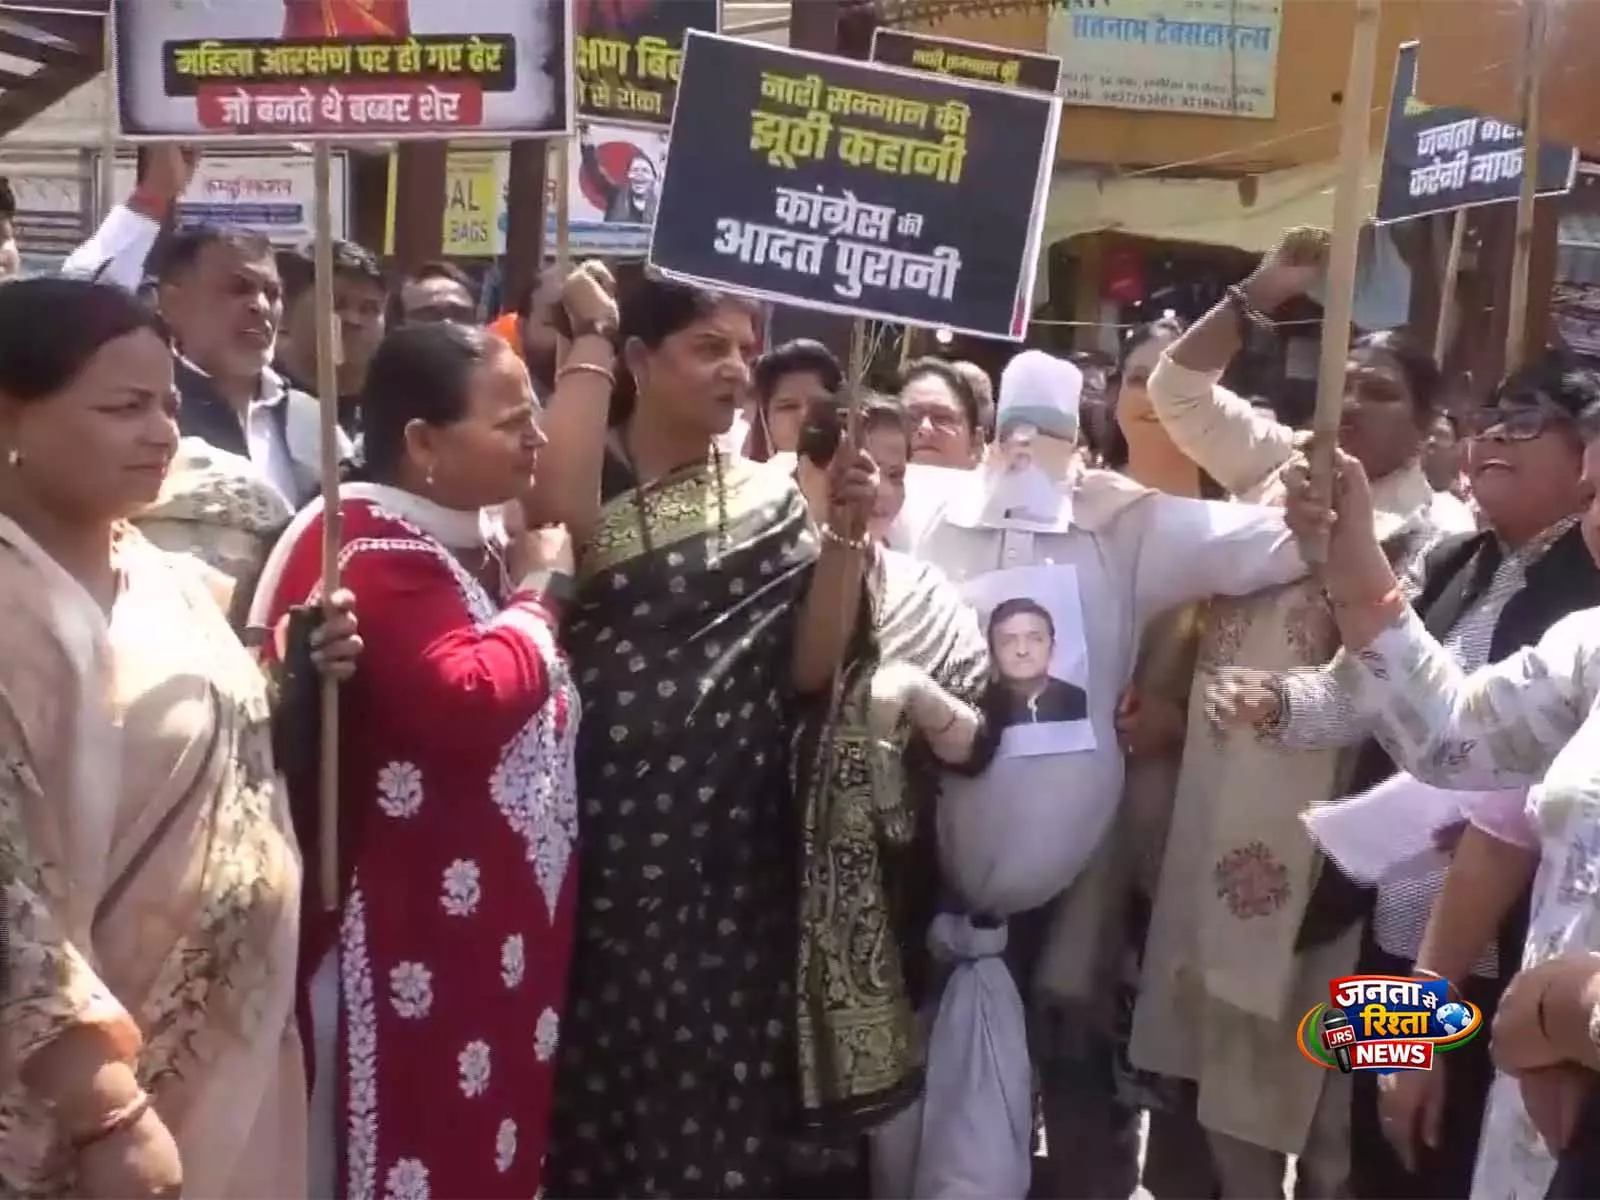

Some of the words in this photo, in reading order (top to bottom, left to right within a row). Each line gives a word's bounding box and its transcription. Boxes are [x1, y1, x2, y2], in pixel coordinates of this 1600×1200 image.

[174, 40, 256, 76] महिला
[260, 45, 350, 75] आरक्षण
[356, 44, 392, 73] पर
[393, 36, 423, 73] हो
[425, 43, 463, 73] गए
[466, 36, 503, 73] ढेर
[216, 86, 250, 125] जो
[254, 86, 315, 124] बनते
[320, 85, 344, 123] थे
[348, 92, 412, 123] बब्बर
[418, 84, 461, 122] शेर
[760, 73, 822, 108] नारी
[826, 86, 930, 129] सम्मान
[934, 101, 971, 135] की
[751, 109, 832, 170] झूठी
[838, 126, 967, 184] कहानी
[1416, 118, 1479, 156] जनता
[1408, 150, 1468, 196] करेगी
[450, 220, 489, 243] BAGS
[775, 184, 896, 242] कांग्रेस
[896, 212, 924, 238] की
[713, 218, 829, 275] आदत
[833, 245, 962, 301] पुरानी
